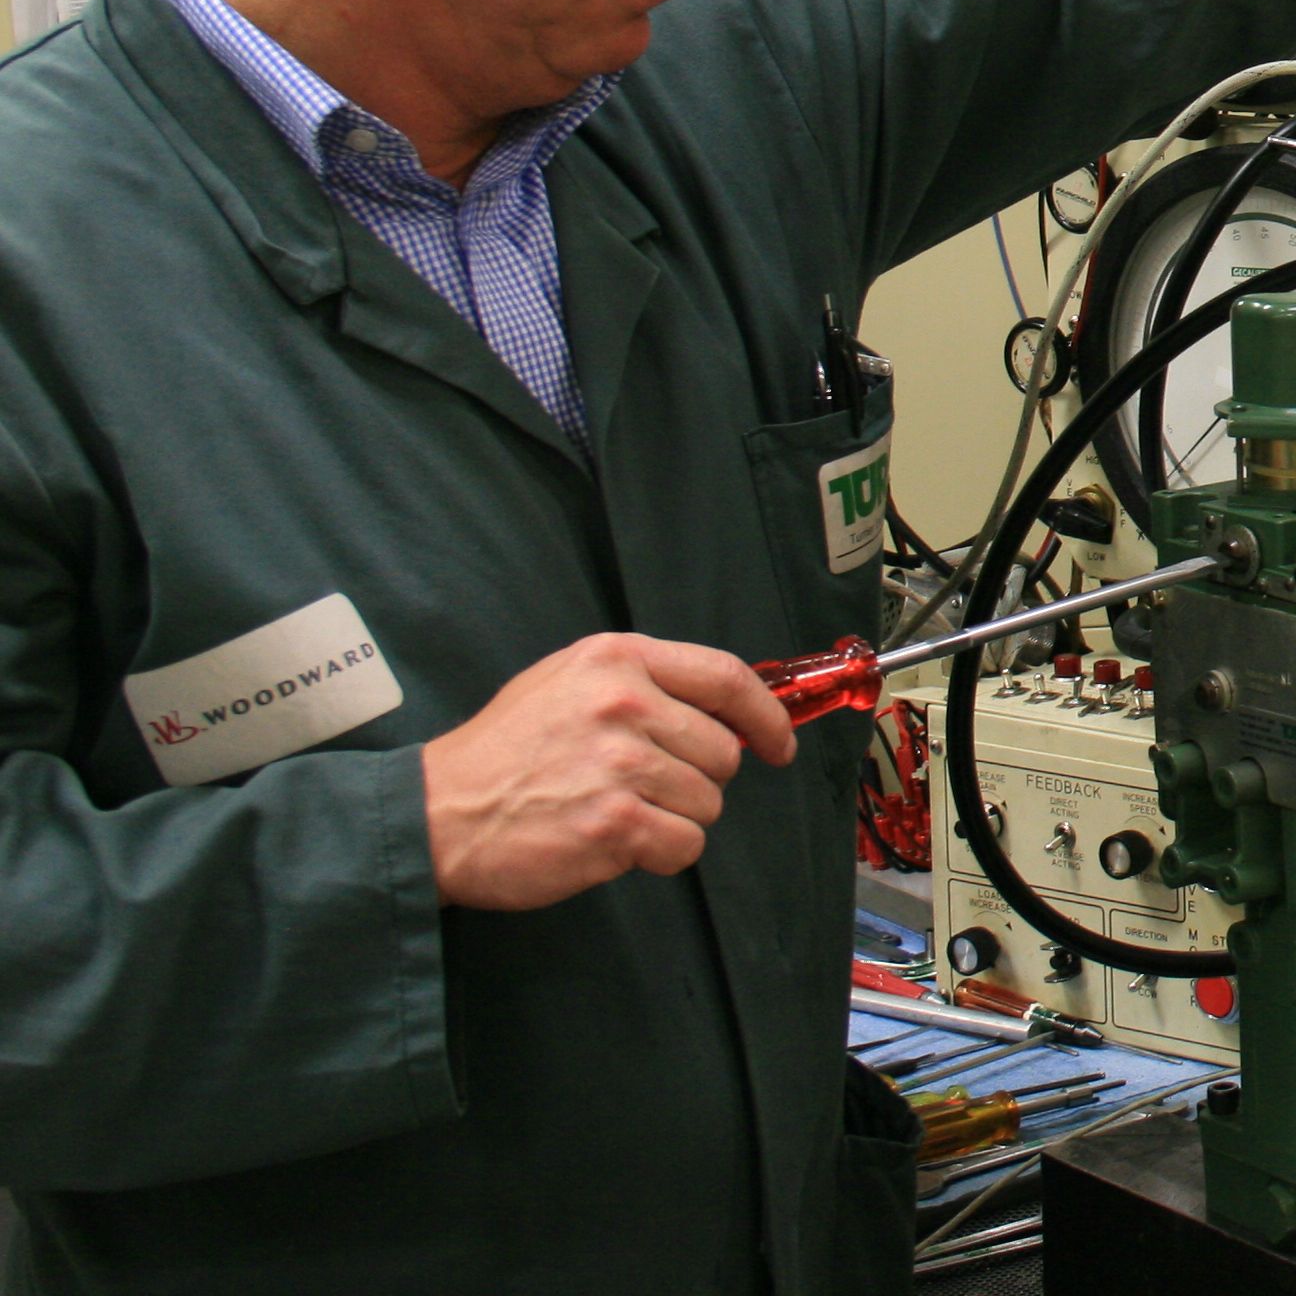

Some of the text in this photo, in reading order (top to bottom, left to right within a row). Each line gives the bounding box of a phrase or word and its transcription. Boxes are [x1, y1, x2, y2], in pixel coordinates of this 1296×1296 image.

[203, 642, 375, 725] WOODWARD
[1026, 773, 1102, 799] FEEDBACK
[1050, 797, 1078, 809] DIRECT
[1122, 793, 1158, 805] INCREAS
[1050, 807, 1080, 820] ACTING
[1129, 804, 1157, 816] SPEED
[1051, 859, 1082, 871] ACTING
[969, 898, 1012, 914] INCREASE
[1125, 926, 1168, 943] DIRECTION
